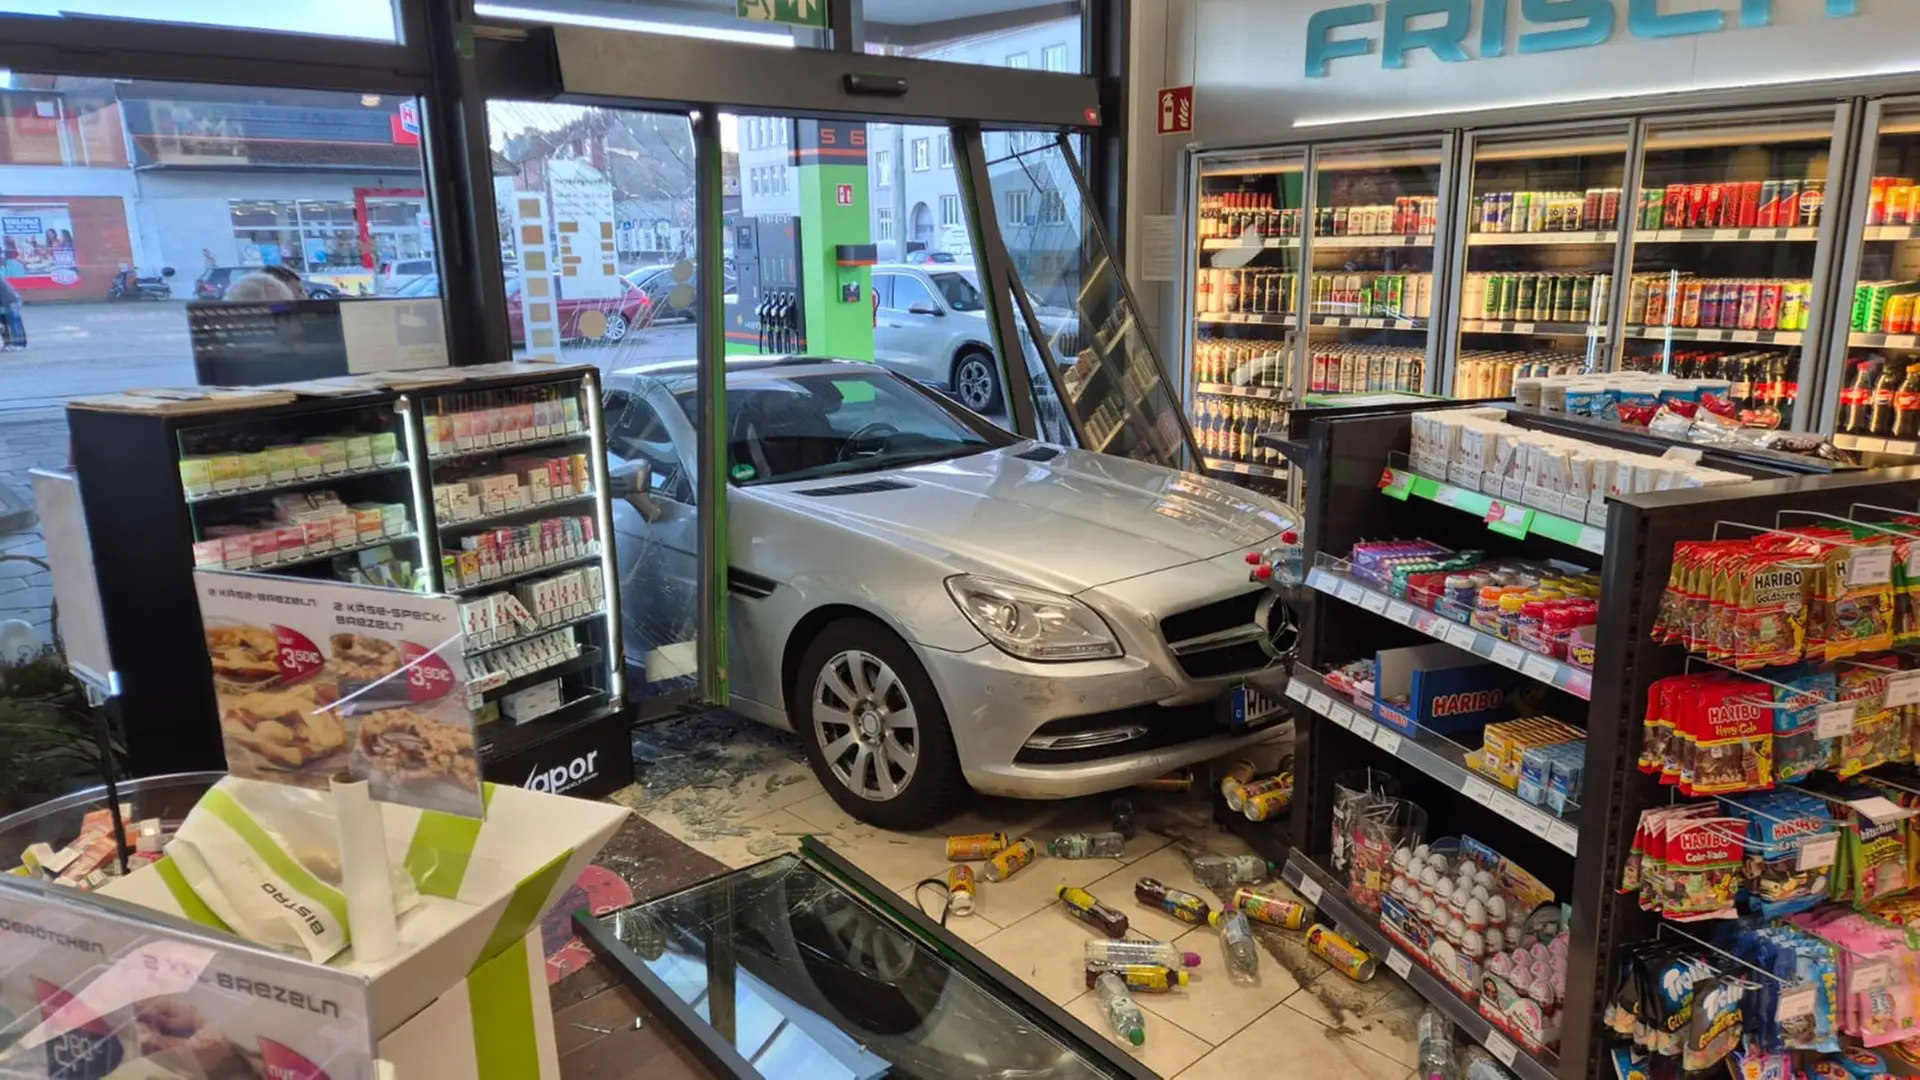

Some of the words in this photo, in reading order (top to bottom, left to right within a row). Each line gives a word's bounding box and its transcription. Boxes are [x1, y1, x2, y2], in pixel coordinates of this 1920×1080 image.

[820, 128, 836, 144] S
[850, 129, 865, 145] 6
[1755, 571, 1802, 590] HARIBO
[207, 587, 217, 597] 2
[219, 588, 317, 608] KÄSE-BREZELN
[333, 602, 343, 611] 2
[347, 604, 447, 623] KÄSE-SPECK-
[336, 616, 403, 632] BREZELN
[1431, 688, 1504, 717] HARIBO
[1708, 704, 1761, 725] HARIBO
[1680, 833, 1733, 851] HARIBO
[261, 883, 325, 936] BISTRO
[143, 954, 159, 970] 2
[216, 971, 340, 1019] BREZELN
